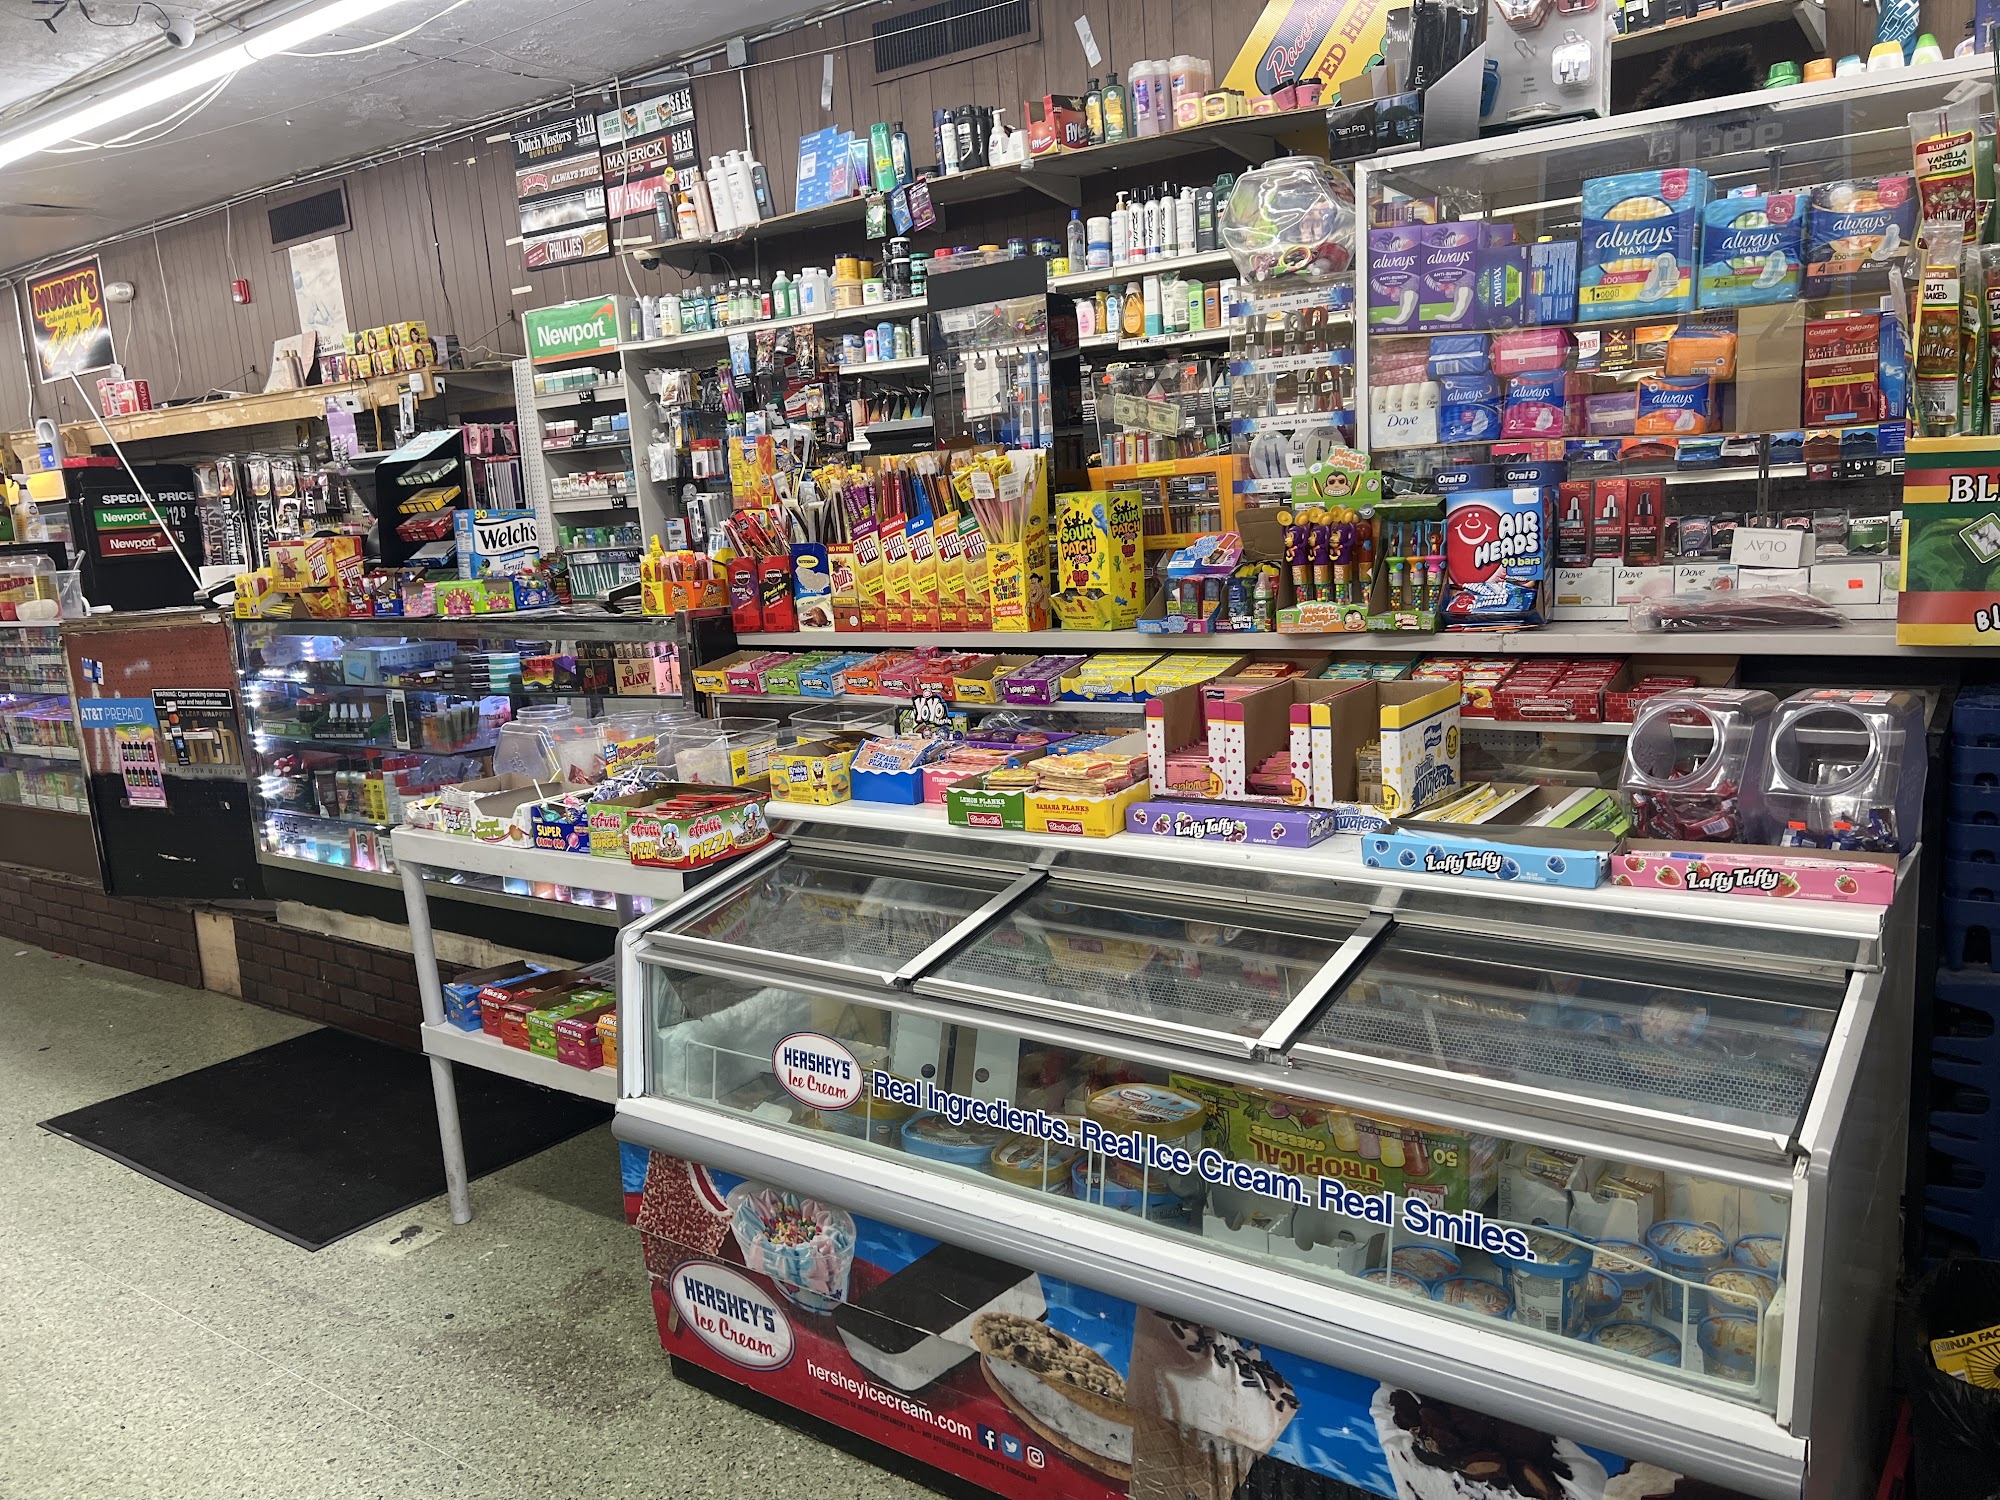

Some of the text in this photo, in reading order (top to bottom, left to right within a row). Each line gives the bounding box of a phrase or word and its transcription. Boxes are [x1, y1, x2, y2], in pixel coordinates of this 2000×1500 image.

[1414, 65, 1424, 85] Pro
[644, 109, 656, 117] INTENSE
[602, 117, 619, 127] INTENSE
[1352, 122, 1366, 132] Pro
[604, 125, 620, 136] COOLING
[518, 130, 572, 154] Dutch Masters
[1927, 138, 1965, 152] BLUNTLIFE
[607, 142, 663, 169] MAVERICK
[1927, 149, 1967, 165] VANILLA
[1929, 158, 1966, 171] FUSION
[551, 165, 599, 184] ALWAYS TRUE
[1668, 183, 1680, 191] 3x
[1886, 190, 1898, 198] 3x
[1774, 206, 1785, 214] 3x
[1833, 215, 1892, 231] always
[1595, 223, 1677, 251] always
[1850, 227, 1868, 235] MAXI
[1721, 232, 1783, 250] always
[549, 236, 583, 262] PHILLIES
[1619, 245, 1646, 256] MAXI
[1739, 246, 1760, 254] MAXI
[1373, 254, 1418, 270] always
[1426, 250, 1473, 267] always
[1834, 253, 1850, 261] 100%
[1817, 262, 1826, 273] 4
[1602, 275, 1623, 284] 100%
[1714, 278, 1721, 288] 2
[35, 274, 97, 316] MURRY'S
[1924, 292, 1947, 300] NAKED
[537, 317, 606, 348] Newport
[1809, 328, 1838, 336] Colgate
[1845, 323, 1875, 332] Colgate
[1579, 339, 1596, 349] PASS
[1604, 344, 1628, 353] STREAM
[1846, 346, 1875, 355] WHITE
[1809, 350, 1839, 359] WHITE
[140, 382, 149, 410] REVLON
[1447, 389, 1483, 402] always
[1512, 387, 1551, 398] always
[1652, 391, 1695, 404] always
[1388, 414, 1419, 428] Dove
[1509, 420, 1517, 429] 2
[1450, 426, 1456, 435] 3
[1438, 473, 1467, 484] Oral-B
[1507, 470, 1538, 481] Oral-B
[102, 492, 195, 504] SPECIAL PRICE
[474, 510, 488, 519] 90
[938, 516, 956, 527] NACHO
[1112, 510, 1139, 523] SOUR
[853, 522, 872, 534] TERIYAKI
[881, 518, 904, 533] ORIGINAL
[911, 519, 924, 530] MILD
[1112, 520, 1140, 537] PATCH
[1499, 511, 1539, 539] AIR
[477, 523, 537, 550] Welch's
[936, 533, 960, 549] slim
[1062, 526, 1094, 542] SOUR
[854, 537, 875, 554] slim
[881, 535, 903, 552] slim
[908, 534, 930, 550] slim
[960, 533, 984, 550] slim
[1122, 544, 1135, 552] BIG
[1744, 540, 1787, 553] OLAY
[888, 547, 908, 564] jim
[915, 546, 934, 564] jim
[942, 546, 961, 564] jim
[1062, 540, 1096, 558] PATCH
[1475, 533, 1539, 568] HEADS
[309, 553, 325, 572] slim
[860, 547, 880, 567] jim
[1502, 557, 1541, 567] 90 bars
[503, 560, 526, 570] Fruit
[832, 567, 854, 592] Bull's
[1072, 570, 1089, 581] BIG
[1559, 570, 1583, 580] Dove
[1618, 569, 1642, 580] Dove
[1679, 566, 1706, 579] Dove
[1232, 616, 1251, 624] QUICK
[584, 676, 608, 689] RAW
[623, 672, 650, 688] RAW
[1080, 684, 1114, 694] Lemonhead
[81, 708, 143, 721] AT&T PREPAID
[914, 697, 943, 722] YoYo
[868, 758, 900, 770] PLANKS
[873, 752, 900, 764] STAGE
[274, 820, 298, 834] EAGLE
[590, 811, 620, 829] efrutti
[689, 816, 722, 838] efrutti
[537, 825, 562, 837] SUPER
[631, 818, 661, 837] efrutti
[1175, 818, 1235, 839] Laffy Taffy
[592, 838, 623, 848] BURGER
[690, 830, 735, 864] PIZZA
[632, 841, 657, 860] PIZZA
[1424, 851, 1503, 875] Laffy Taffy
[1686, 868, 1780, 894] Laffy Taffy
[783, 1045, 853, 1082] HERSHEY'S
[787, 1066, 849, 1100] Ice Cream
[1251, 1125, 1326, 1151] FREEZIES
[874, 1071, 1536, 1259] Real Ingredients. Real Ice Cream. Real Smiles.
[1248, 1137, 1384, 1187] TROPICAL
[1433, 1149, 1458, 1167] 50
[683, 1275, 777, 1333] HERSHEY'S
[694, 1305, 777, 1359] Ice Cream
[807, 1359, 973, 1441] hersheyicecream.com
